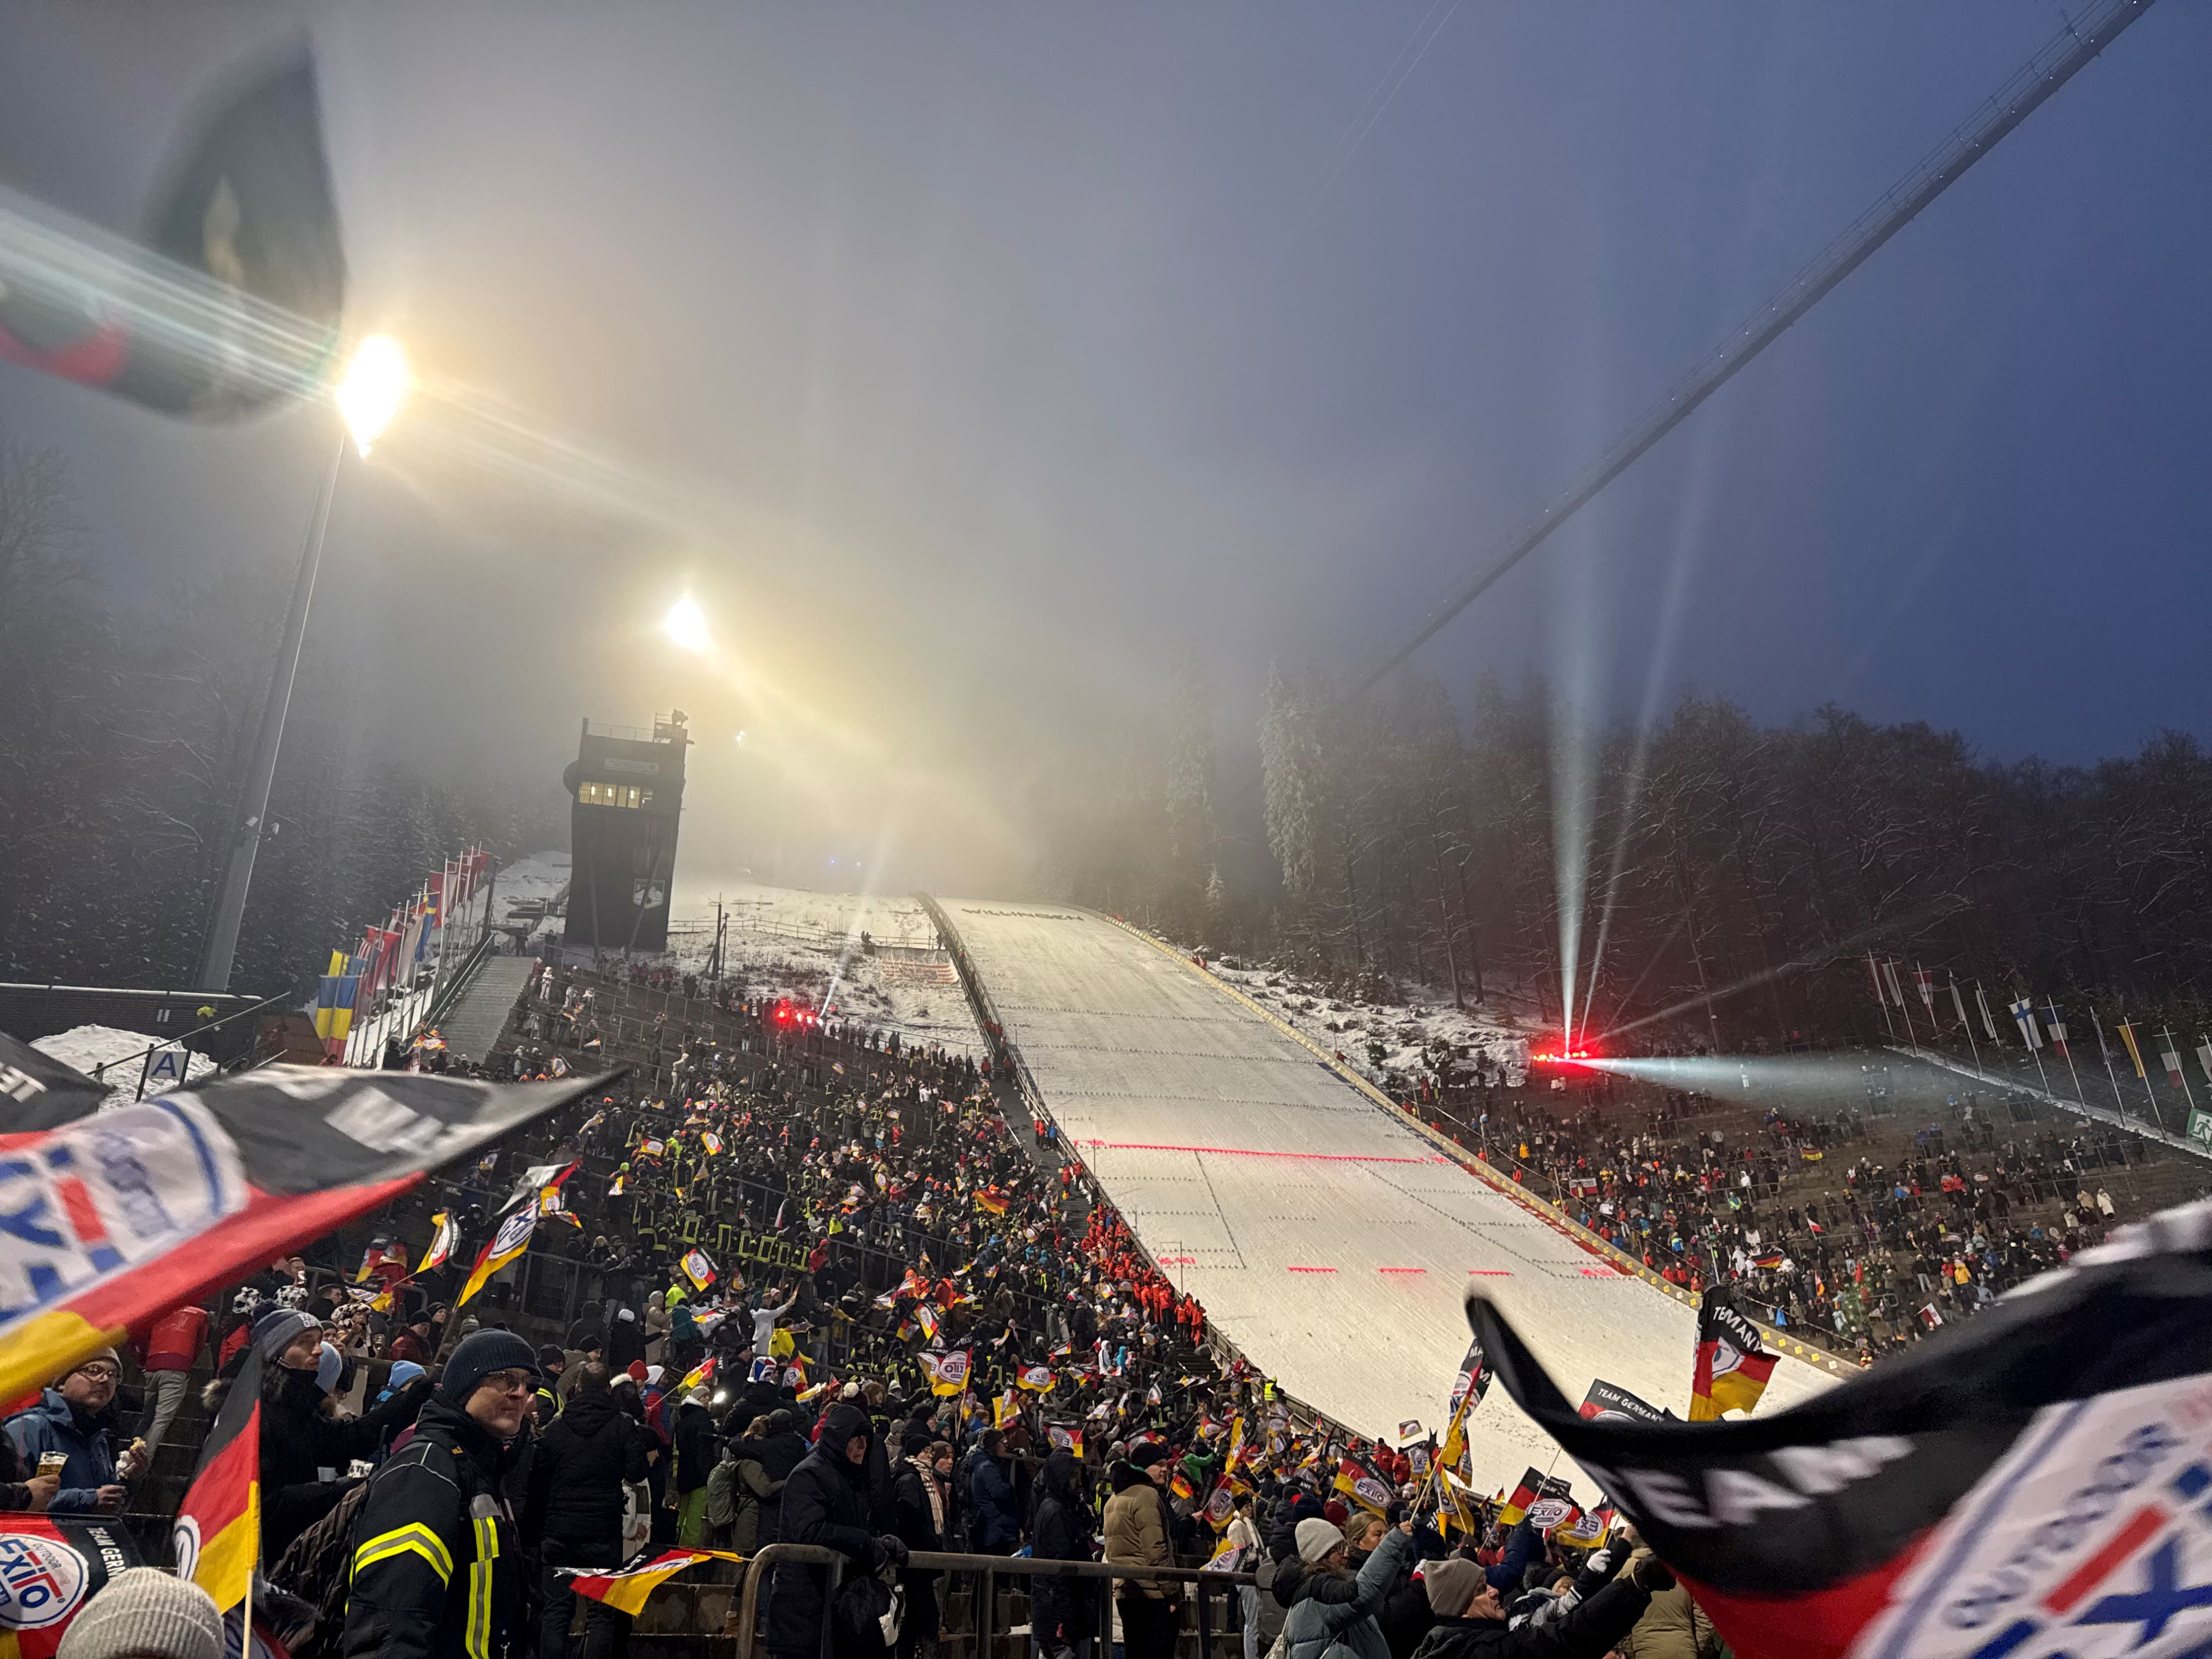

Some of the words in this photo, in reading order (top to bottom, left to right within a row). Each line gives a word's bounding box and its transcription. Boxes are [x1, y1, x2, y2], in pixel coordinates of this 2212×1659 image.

[151, 1052, 176, 1077] A
[1598, 1388, 1622, 1403] TEAM
[1621, 1398, 1665, 1422] GERMANY
[85, 1527, 116, 1546] TEAM
[33, 1542, 62, 1569] OUTDOOR
